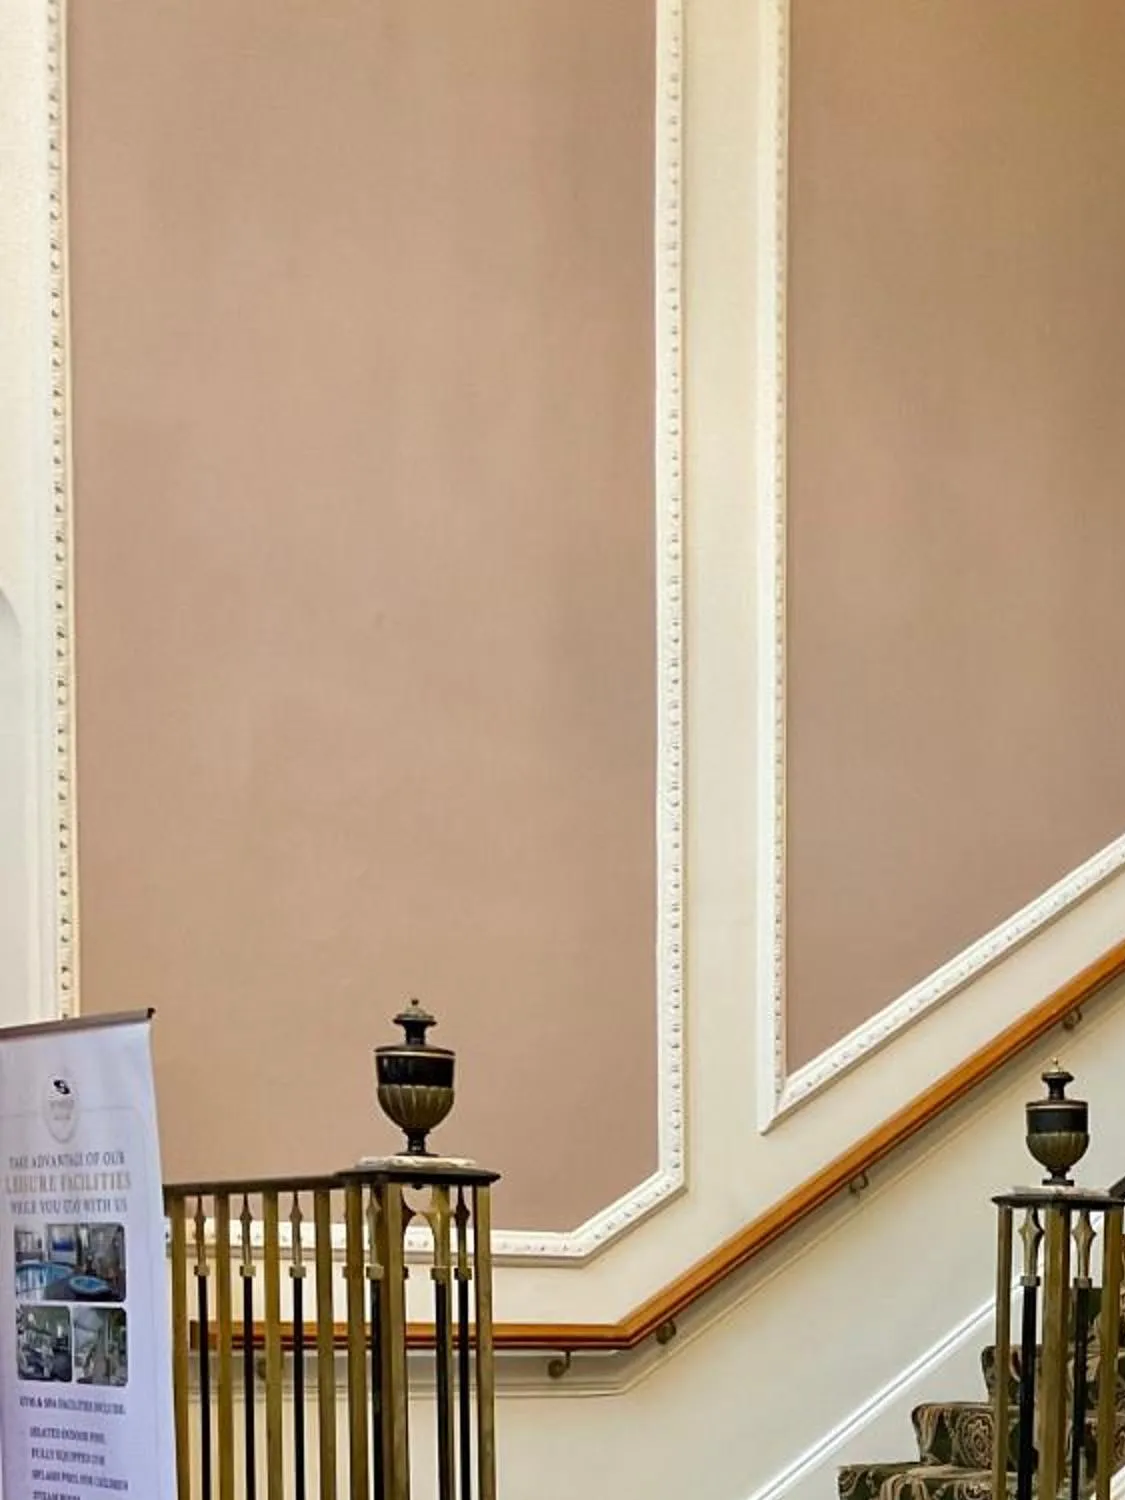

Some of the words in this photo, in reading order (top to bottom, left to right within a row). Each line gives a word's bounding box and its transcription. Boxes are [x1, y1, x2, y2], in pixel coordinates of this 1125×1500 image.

[102, 1151, 125, 1166] OUR
[61, 1171, 132, 1192] FACILITIES
[40, 1200, 60, 1215] YOU
